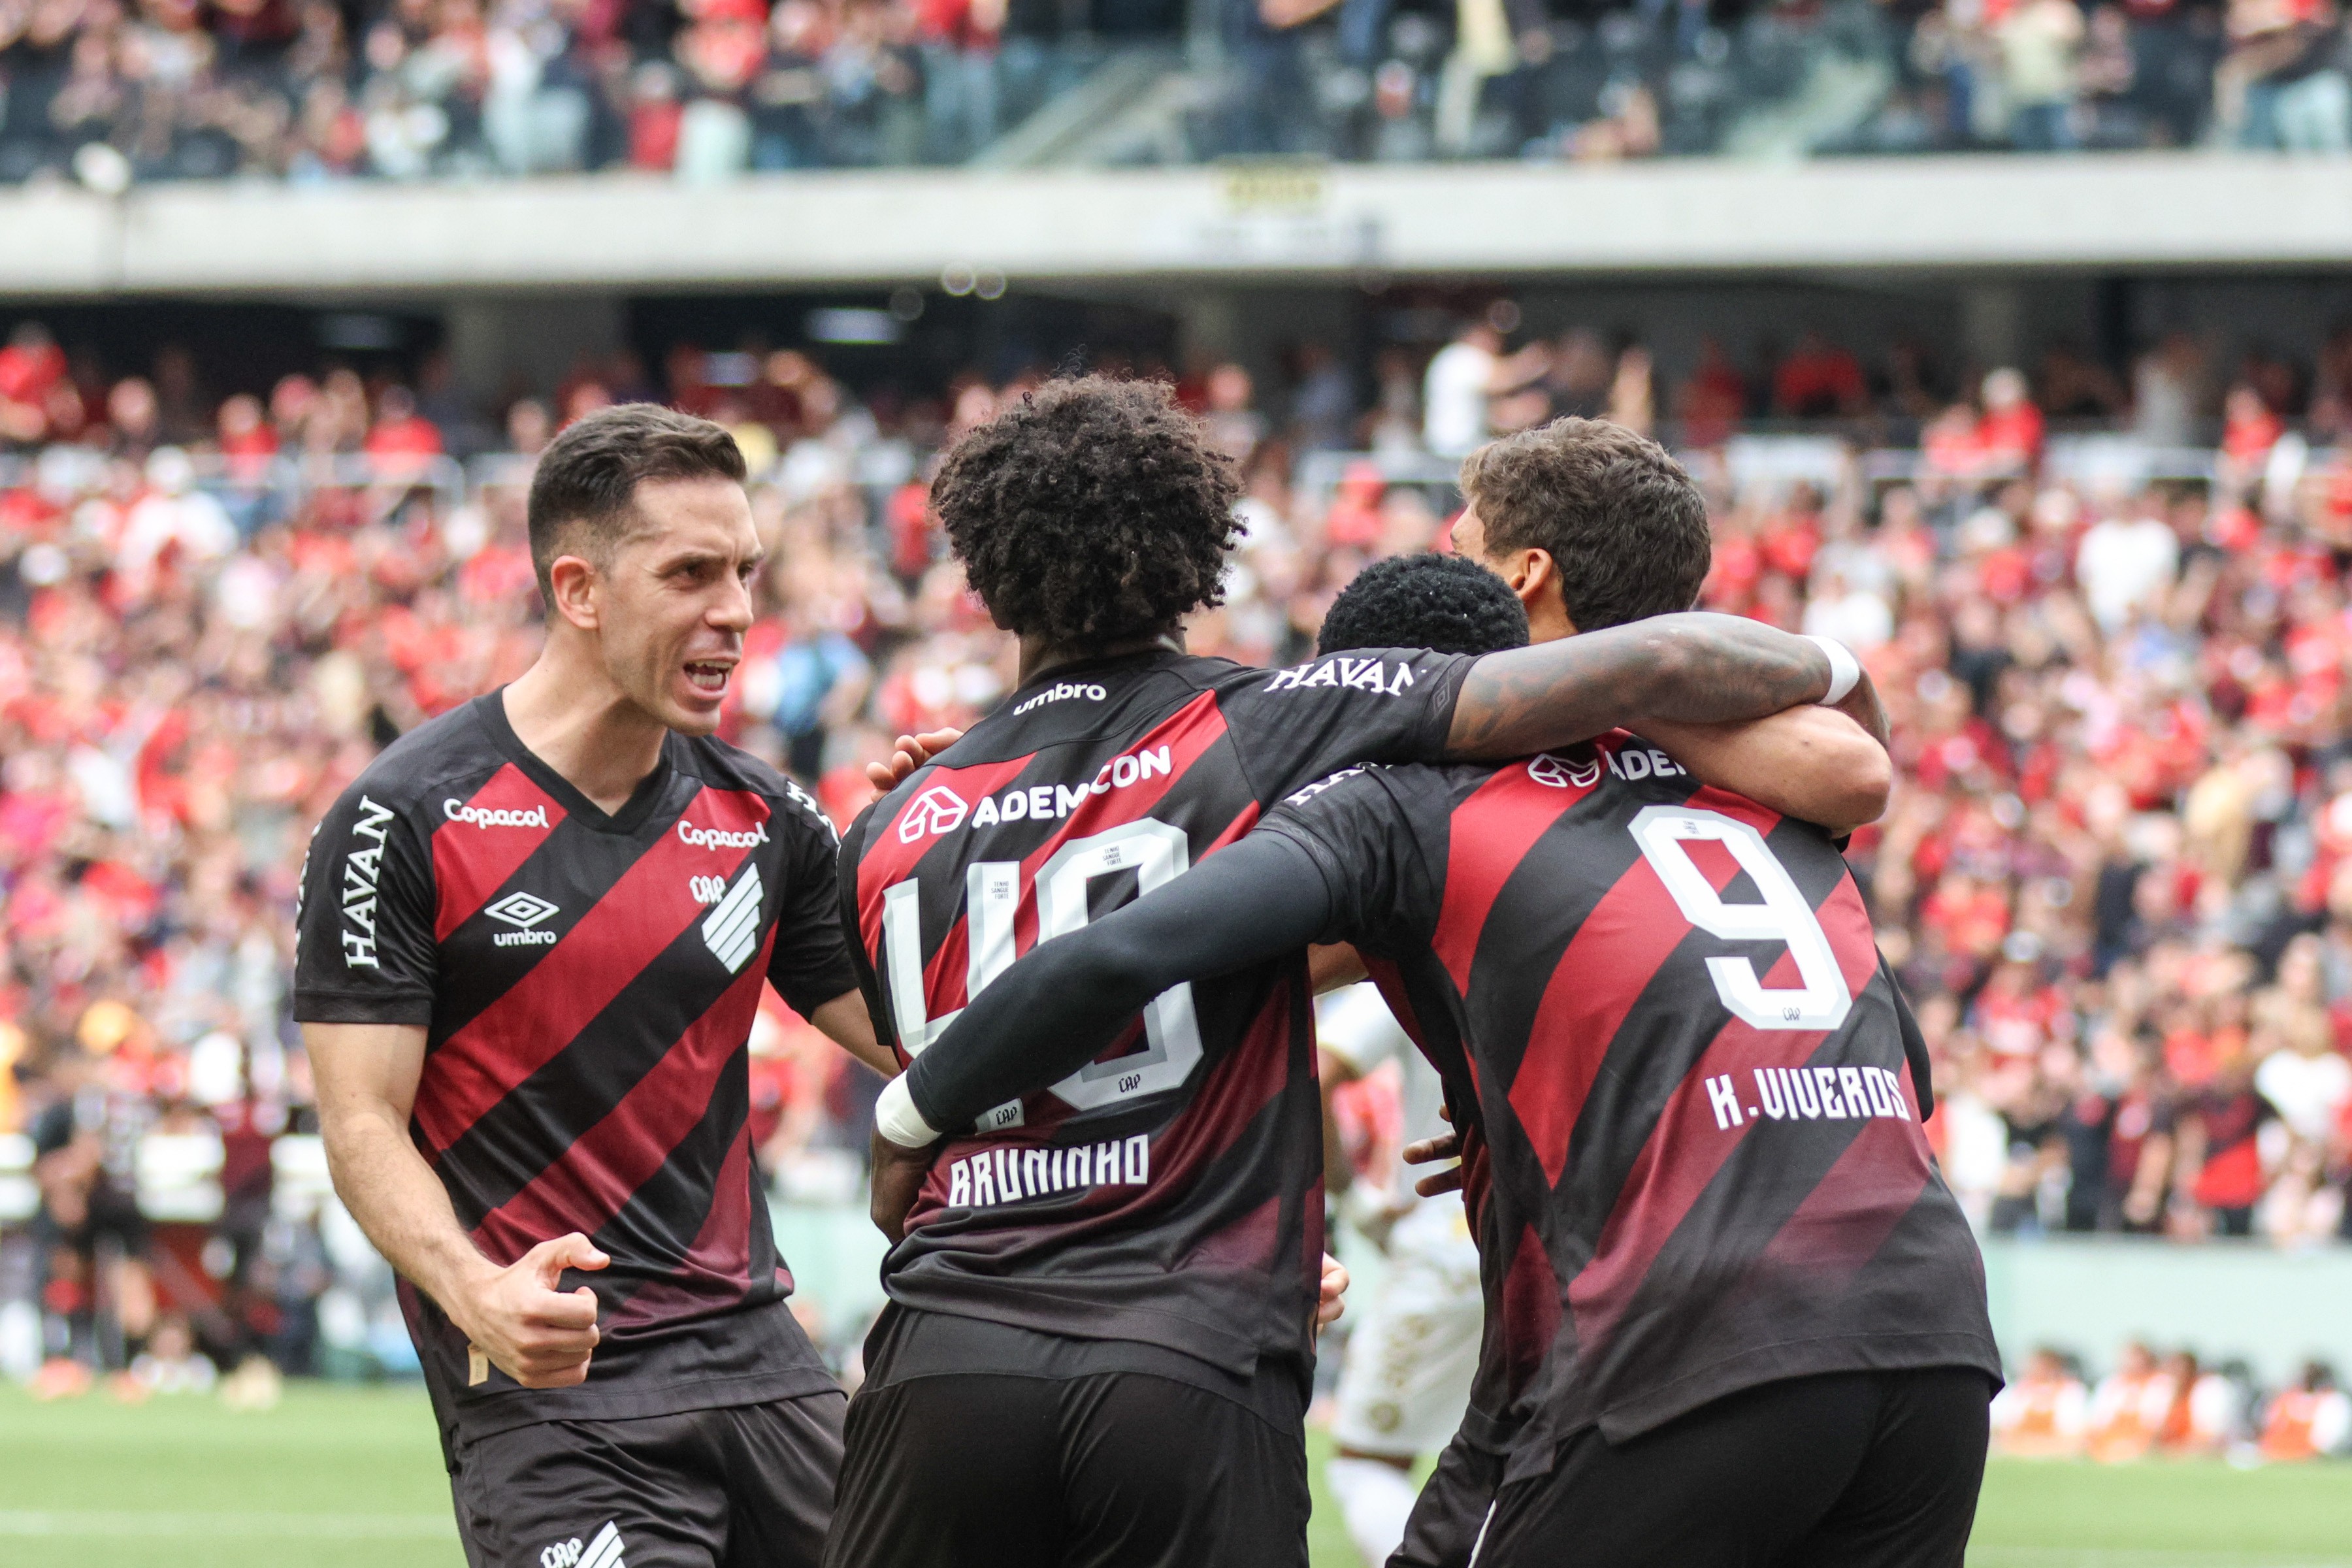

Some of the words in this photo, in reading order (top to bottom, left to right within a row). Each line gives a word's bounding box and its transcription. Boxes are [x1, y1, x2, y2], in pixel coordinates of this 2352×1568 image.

[1013, 683, 1107, 716] umbro
[972, 745, 1171, 828] ADEMCON
[443, 798, 550, 830] Copacol
[678, 820, 771, 851] Copacol
[1102, 852, 1120, 861] SANGUE
[1107, 857, 1122, 866] FORTE
[342, 794, 395, 970] HAVAN
[689, 875, 727, 904] CAP
[1627, 805, 1853, 1030] 9
[493, 928, 557, 947] umbro
[1119, 1073, 1141, 1093] CAP
[1705, 1067, 1911, 1130] K.VIVEROS
[996, 1106, 1017, 1126] CAP
[948, 1134, 1149, 1207] BRUNINHO
